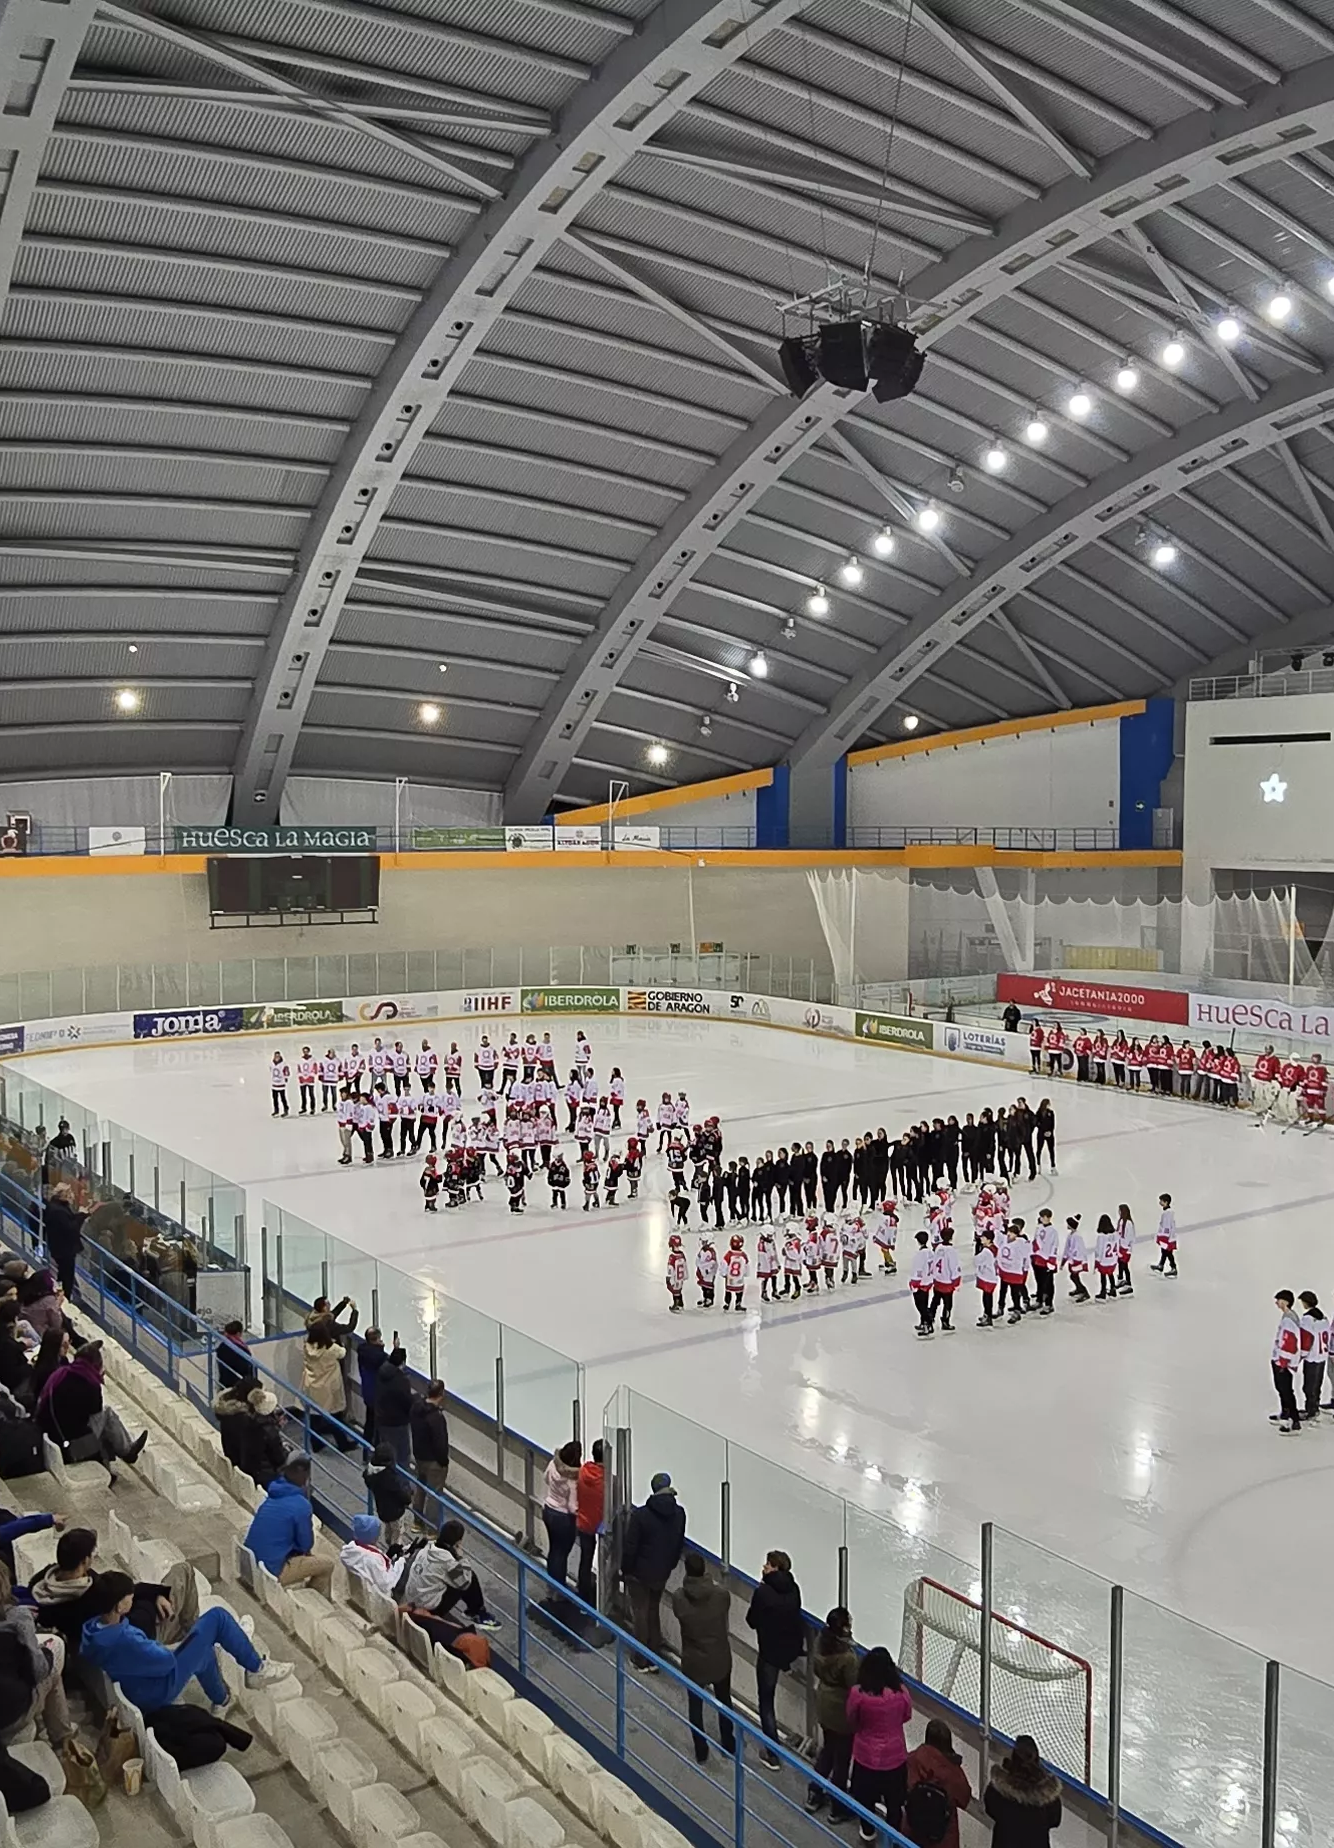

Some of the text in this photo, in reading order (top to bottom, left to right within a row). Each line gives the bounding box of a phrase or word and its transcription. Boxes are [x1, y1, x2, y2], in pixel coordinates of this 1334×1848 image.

[544, 994, 619, 1007] IBERDROLA
[647, 990, 703, 1003] GOBIERNO
[1058, 985, 1145, 1005] JACETANIA2000
[474, 996, 512, 1011] IIHF
[647, 1001, 662, 1011] DE
[878, 1025, 926, 1042] IBERDROLA
[963, 1031, 1007, 1047] LOTERÍAS
[730, 1261, 741, 1277] 8
